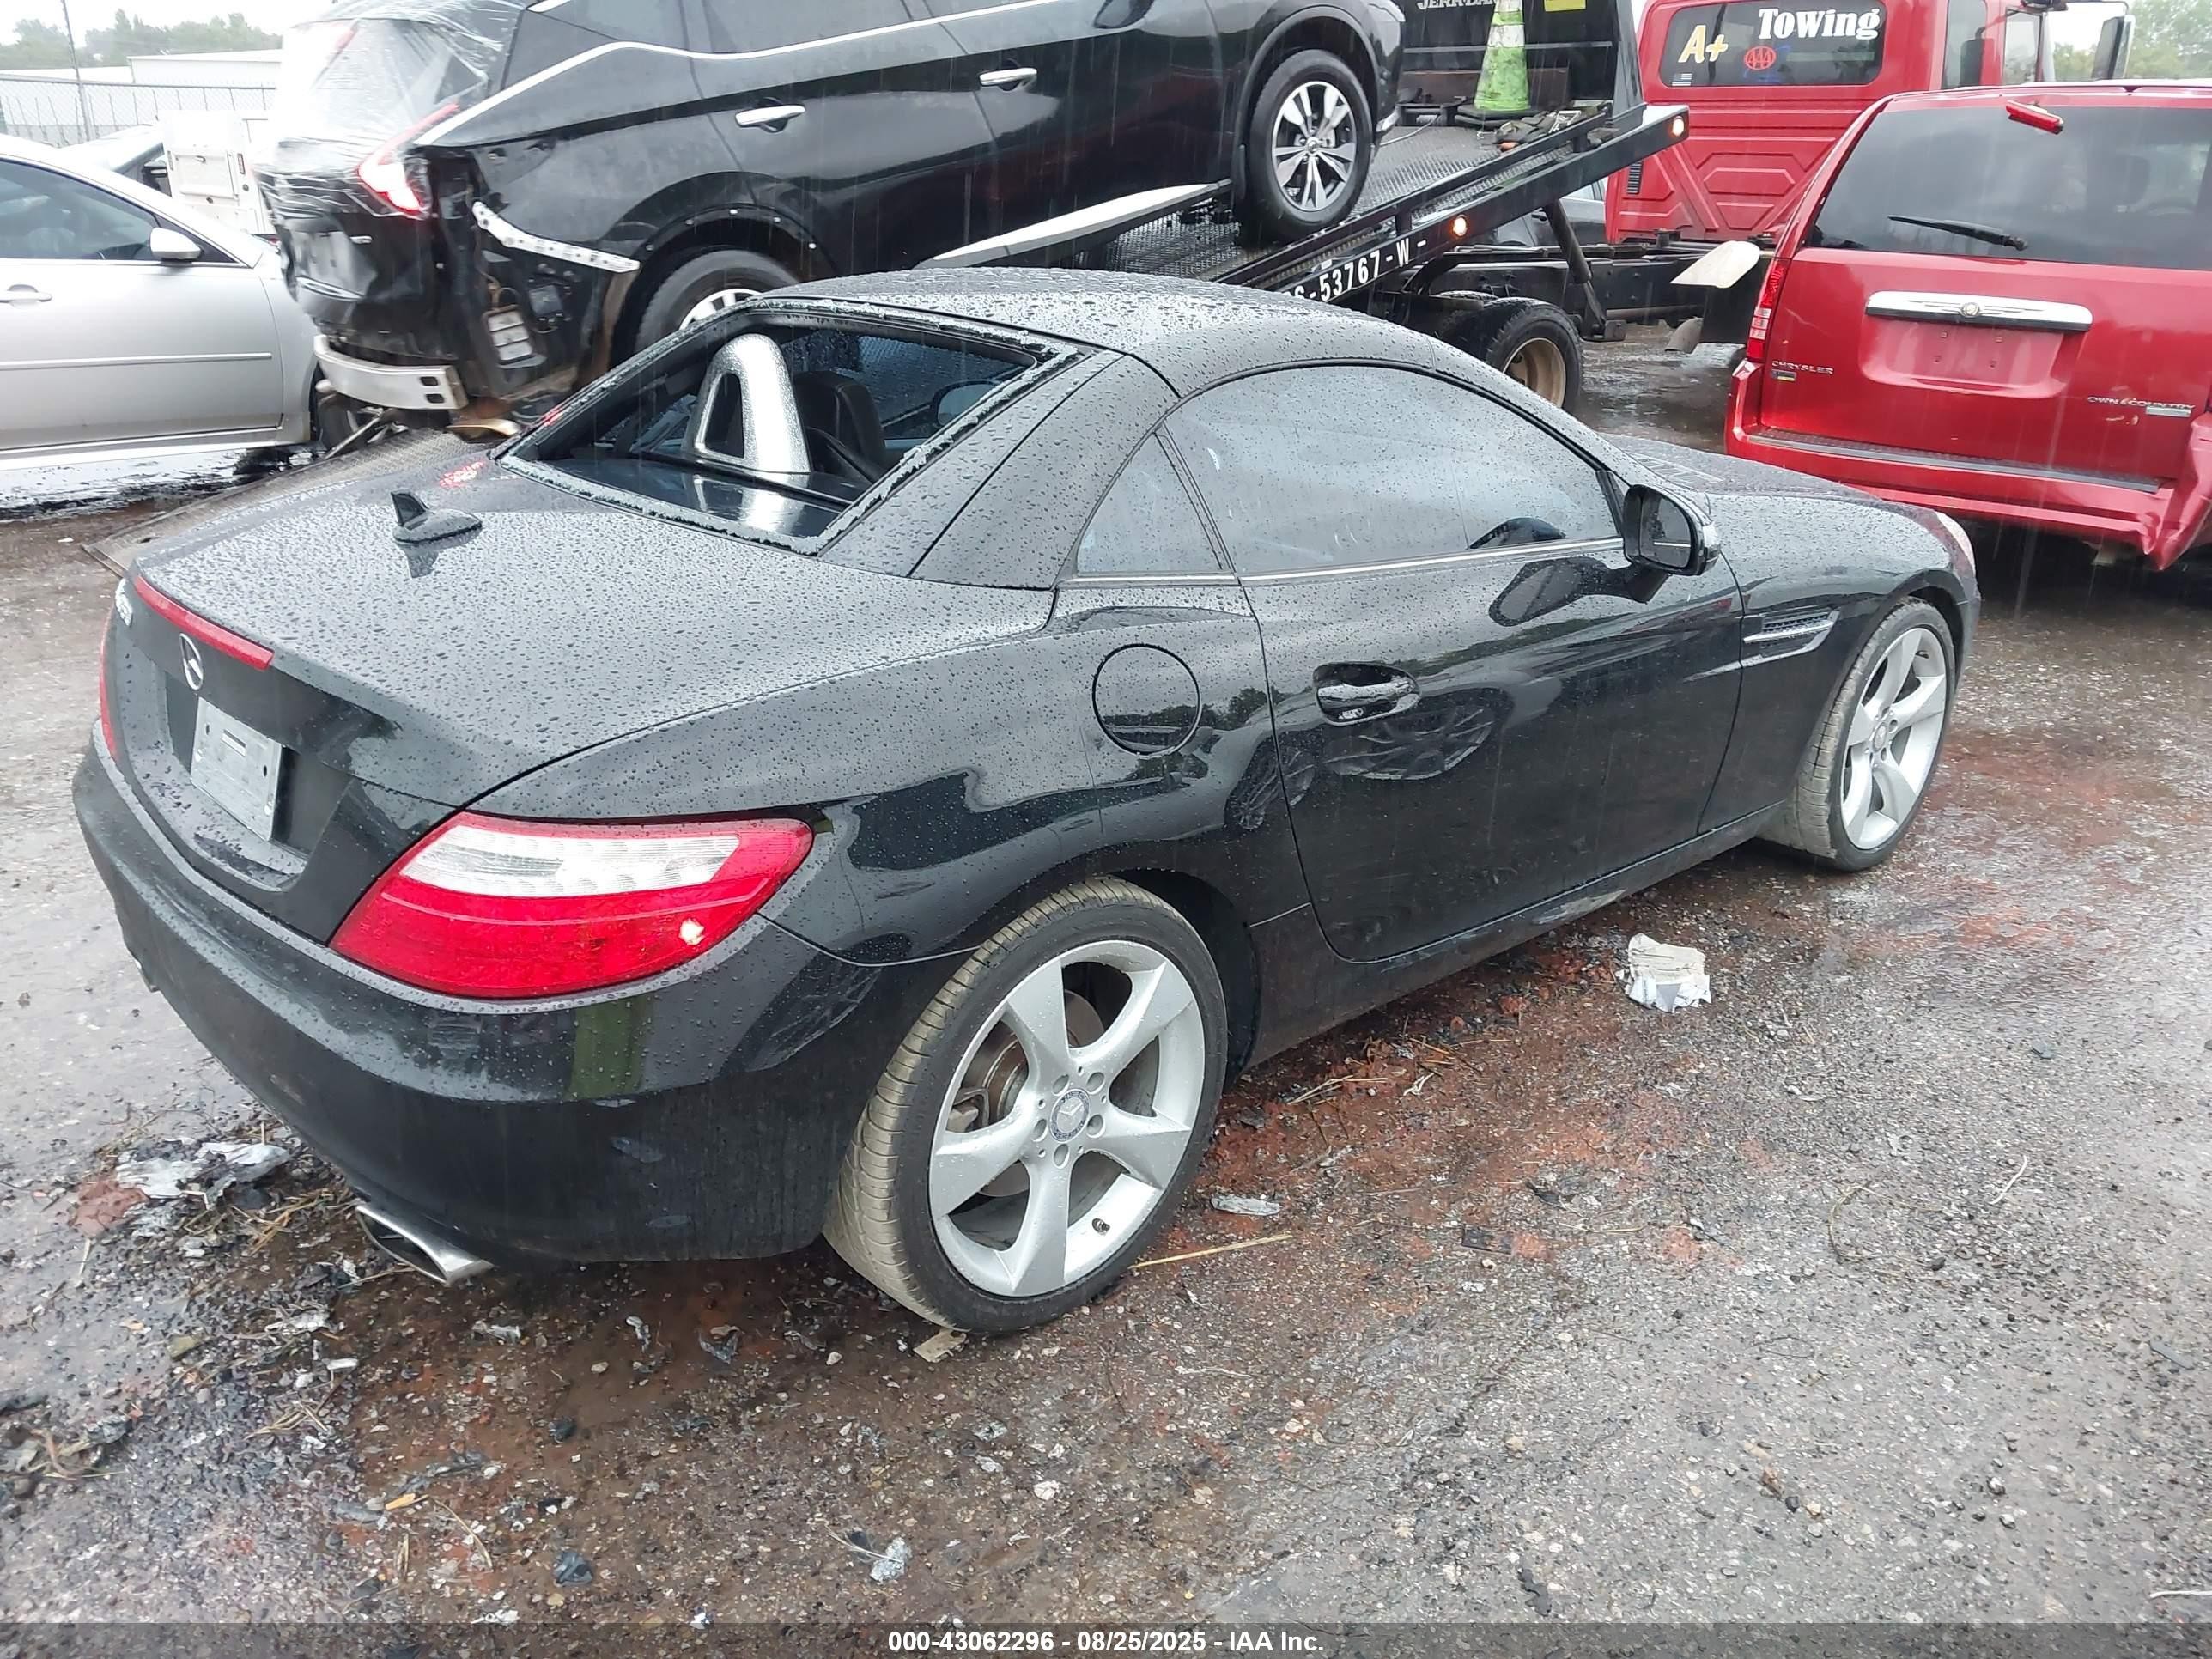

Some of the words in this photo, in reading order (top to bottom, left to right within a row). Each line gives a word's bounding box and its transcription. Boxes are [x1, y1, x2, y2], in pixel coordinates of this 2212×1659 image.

[1678, 24, 1729, 64] A+
[1758, 8, 1881, 40] Towing
[1771, 360, 1834, 374] CHRYSLER
